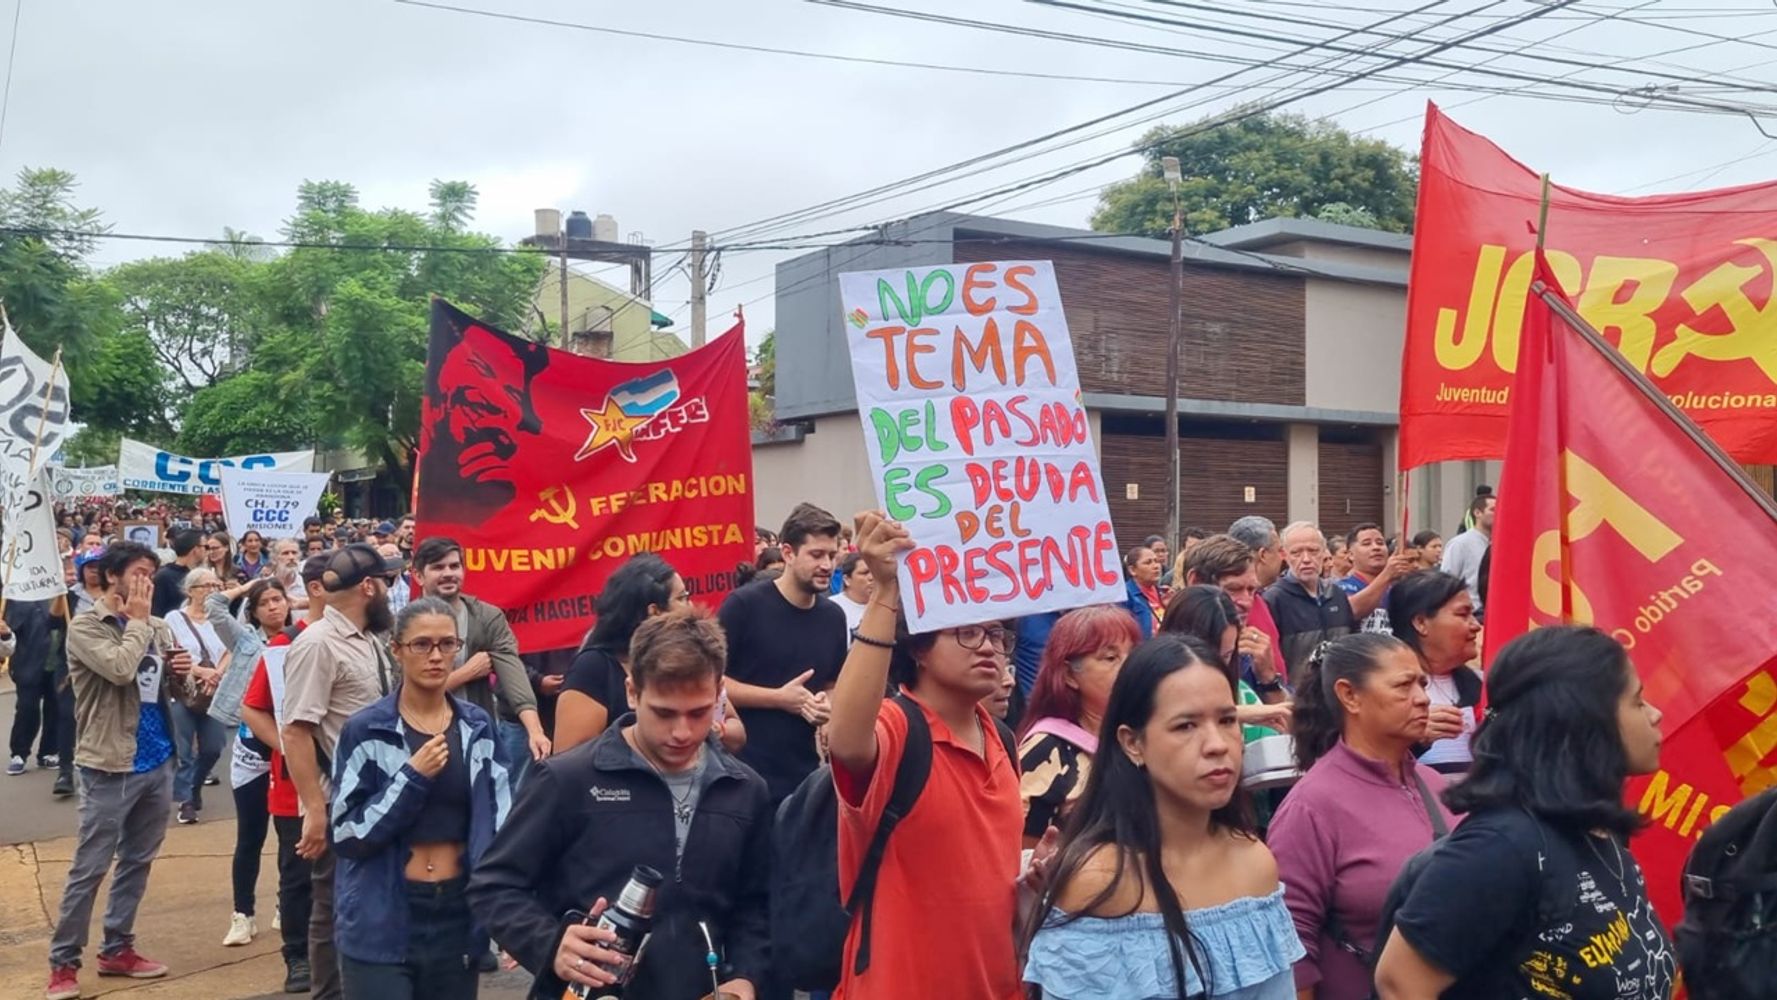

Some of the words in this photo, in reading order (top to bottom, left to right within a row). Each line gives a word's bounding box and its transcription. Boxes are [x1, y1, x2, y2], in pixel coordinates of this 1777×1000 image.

[878, 269, 954, 326] NO
[962, 263, 1038, 316] ES
[866, 317, 1056, 391] TEMA
[1436, 382, 1510, 405] Juventud
[1667, 391, 1777, 410] oluciona
[870, 399, 949, 466] DEL
[950, 395, 1087, 456] PASADO
[122, 478, 188, 493] CORRIENTE
[192, 485, 219, 494] CLAS
[884, 464, 952, 520] ES
[965, 456, 1099, 509] DEUDA
[252, 509, 290, 522] CCC
[275, 500, 300, 509] 179
[246, 522, 293, 530] MISIONES
[955, 502, 1031, 544] DEL
[465, 546, 576, 572] UVENI
[904, 521, 1118, 618] PRESENTE
